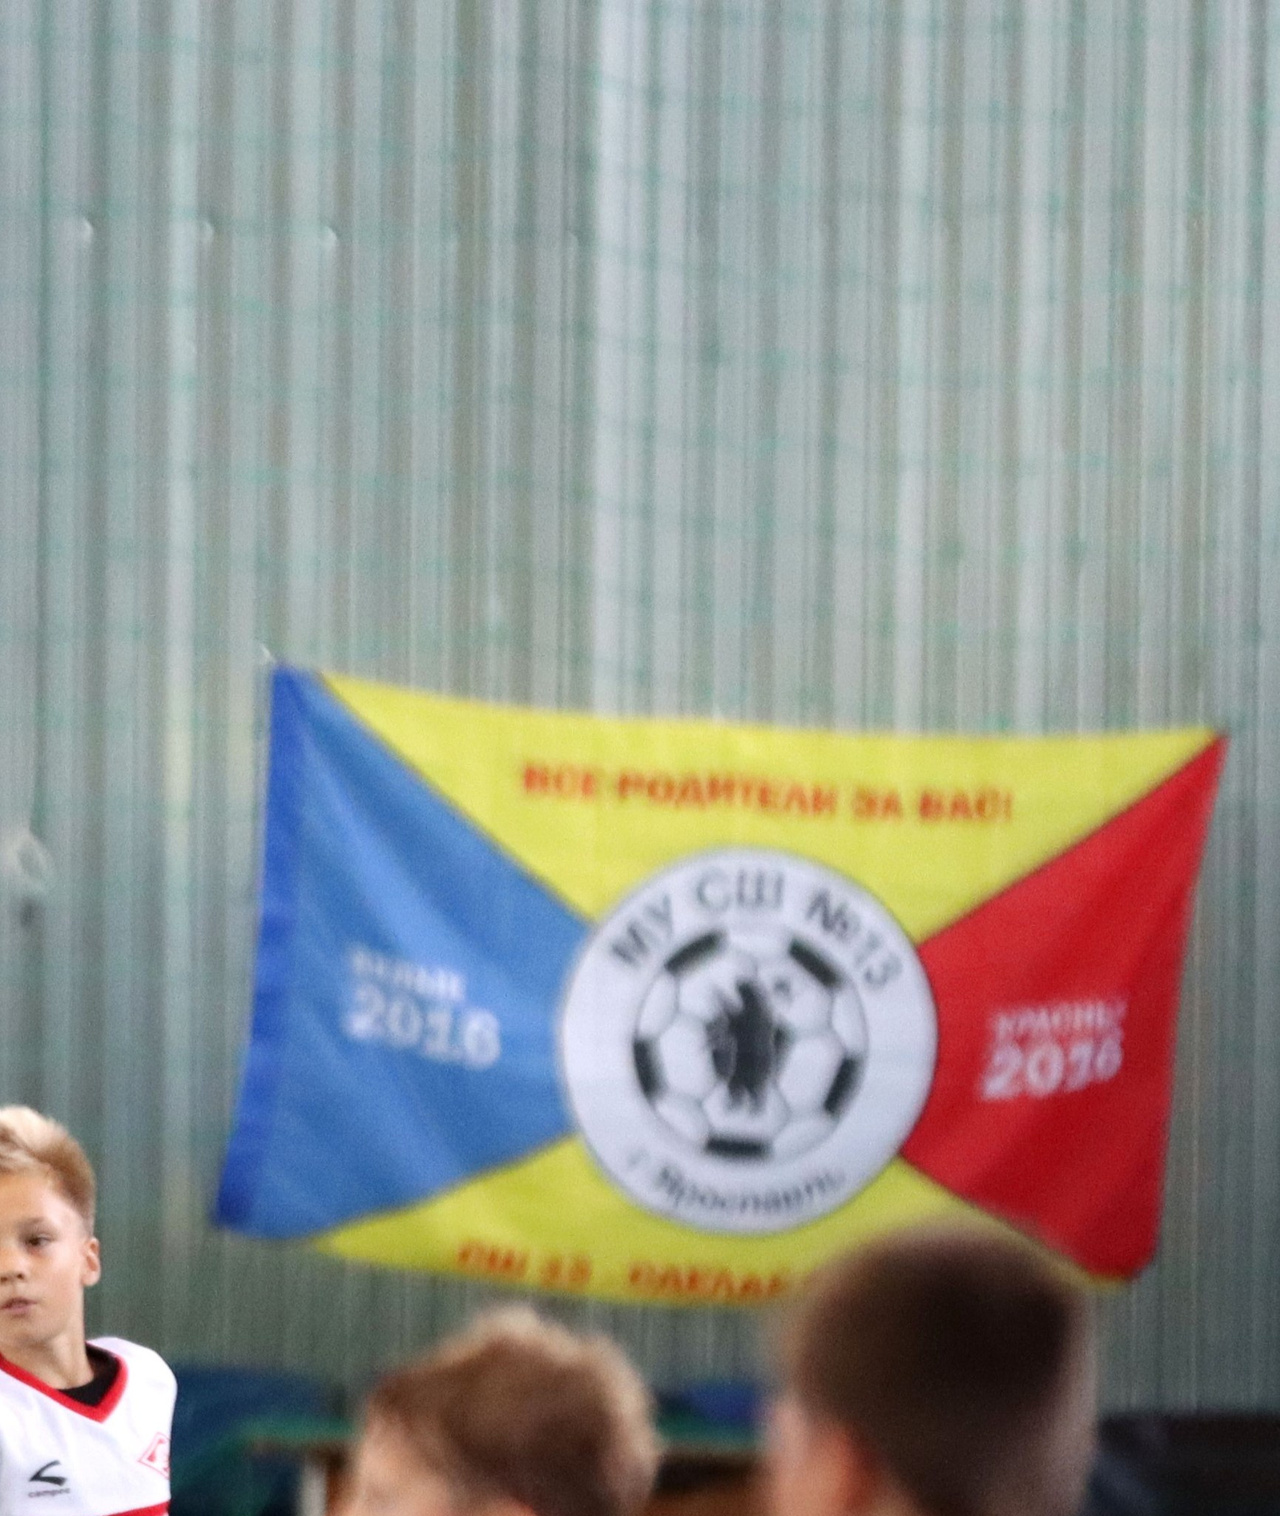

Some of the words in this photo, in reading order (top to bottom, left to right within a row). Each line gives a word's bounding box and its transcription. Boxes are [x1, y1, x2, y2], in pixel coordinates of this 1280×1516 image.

[609, 894, 676, 967] МУ
[695, 867, 785, 911] СШ
[345, 981, 502, 1072] 2016
